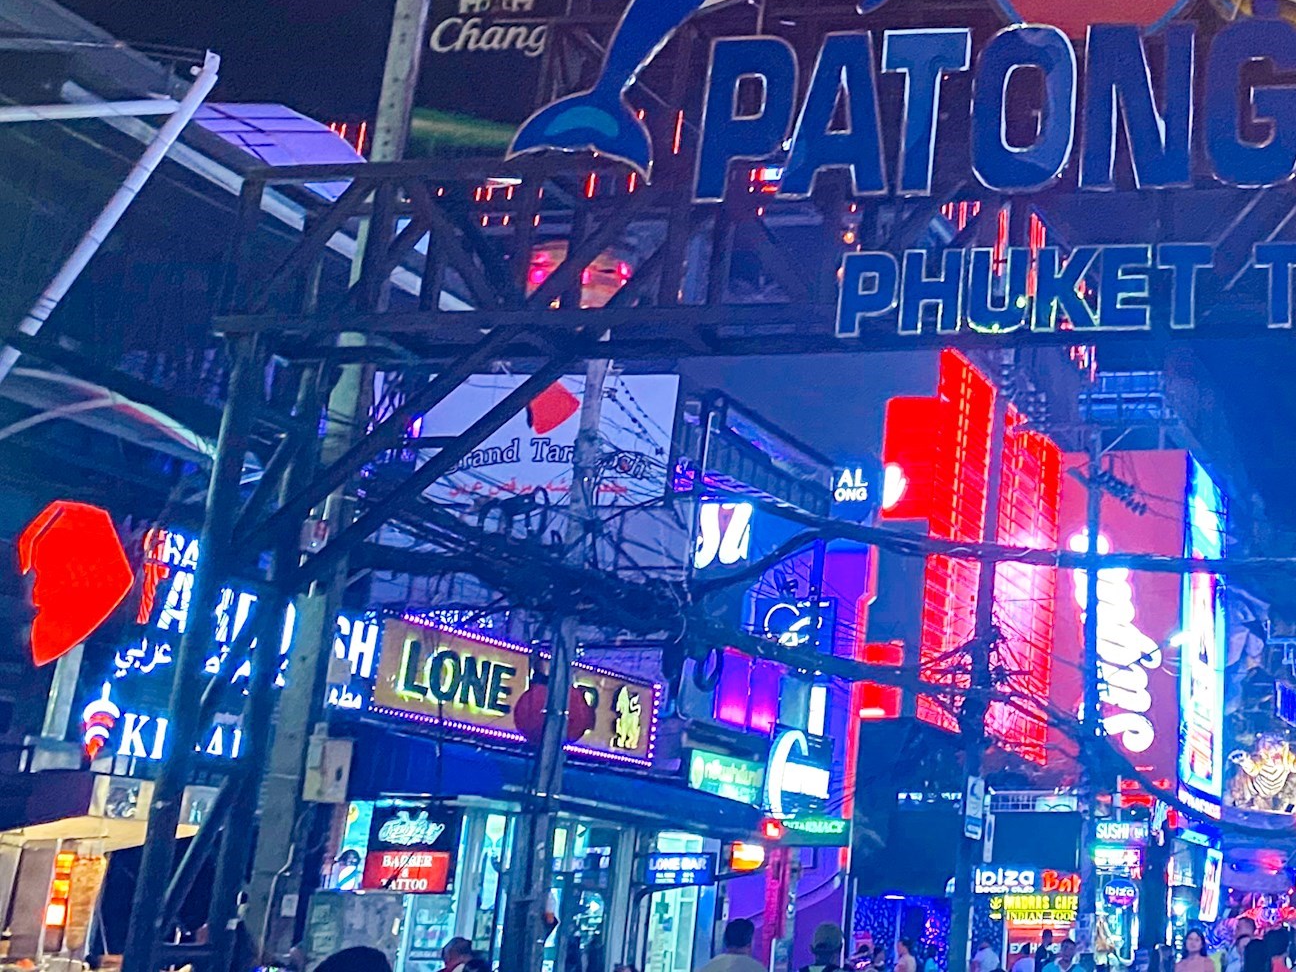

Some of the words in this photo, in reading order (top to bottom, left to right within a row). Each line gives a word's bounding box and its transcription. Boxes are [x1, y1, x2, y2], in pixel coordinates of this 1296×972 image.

[429, 17, 550, 58] Chang
[835, 242, 1215, 338] PHUKET
[396, 637, 516, 716] LONE
[1096, 823, 1130, 840] SUSHI
[649, 857, 680, 871] LONE
[1006, 910, 1043, 921] INDIAN
